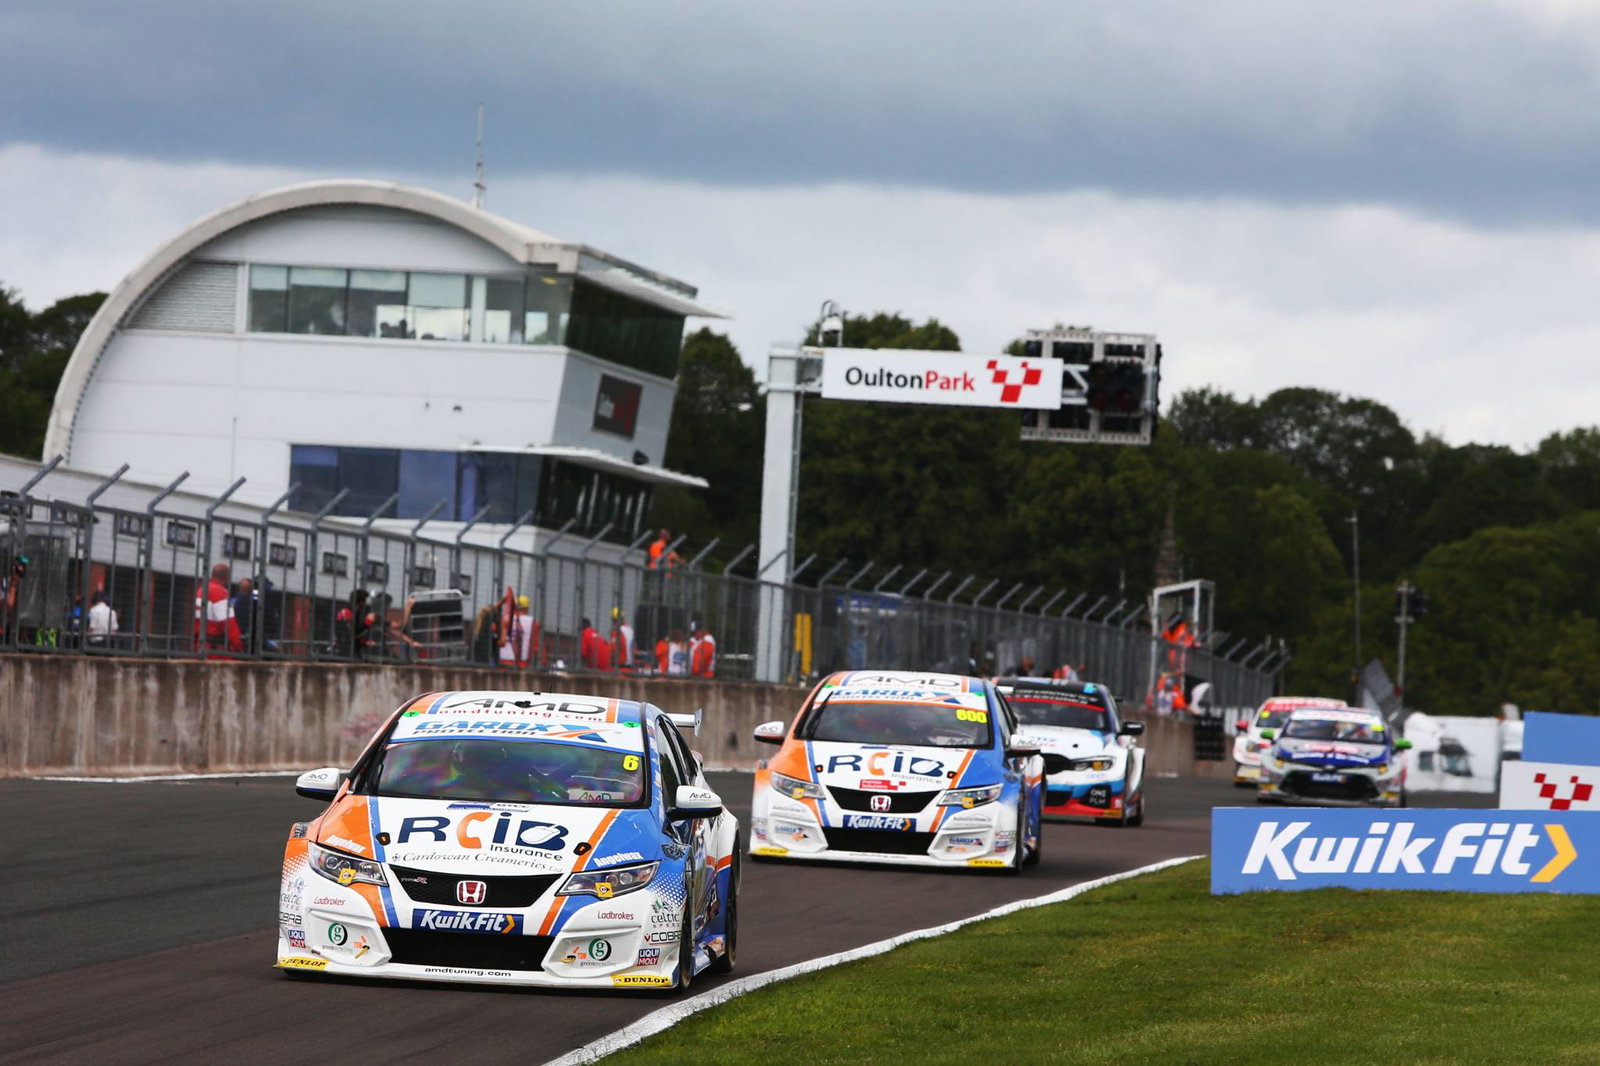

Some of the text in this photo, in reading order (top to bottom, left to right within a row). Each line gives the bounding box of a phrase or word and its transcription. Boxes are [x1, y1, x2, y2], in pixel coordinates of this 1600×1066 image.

[444, 698, 606, 714] AMD
[623, 755, 639, 771] 6
[490, 844, 563, 862] Insurance
[403, 851, 470, 862] Cardowan
[474, 852, 551, 870] Creameries
[593, 852, 644, 867] Angelwax
[313, 896, 346, 907] Ladbrokes
[598, 911, 634, 920] Ladbrokes
[650, 912, 680, 924] celtic
[640, 949, 659, 957] LIQUI
[638, 957, 658, 965] MOLY
[424, 968, 512, 977] amdtuning.com
